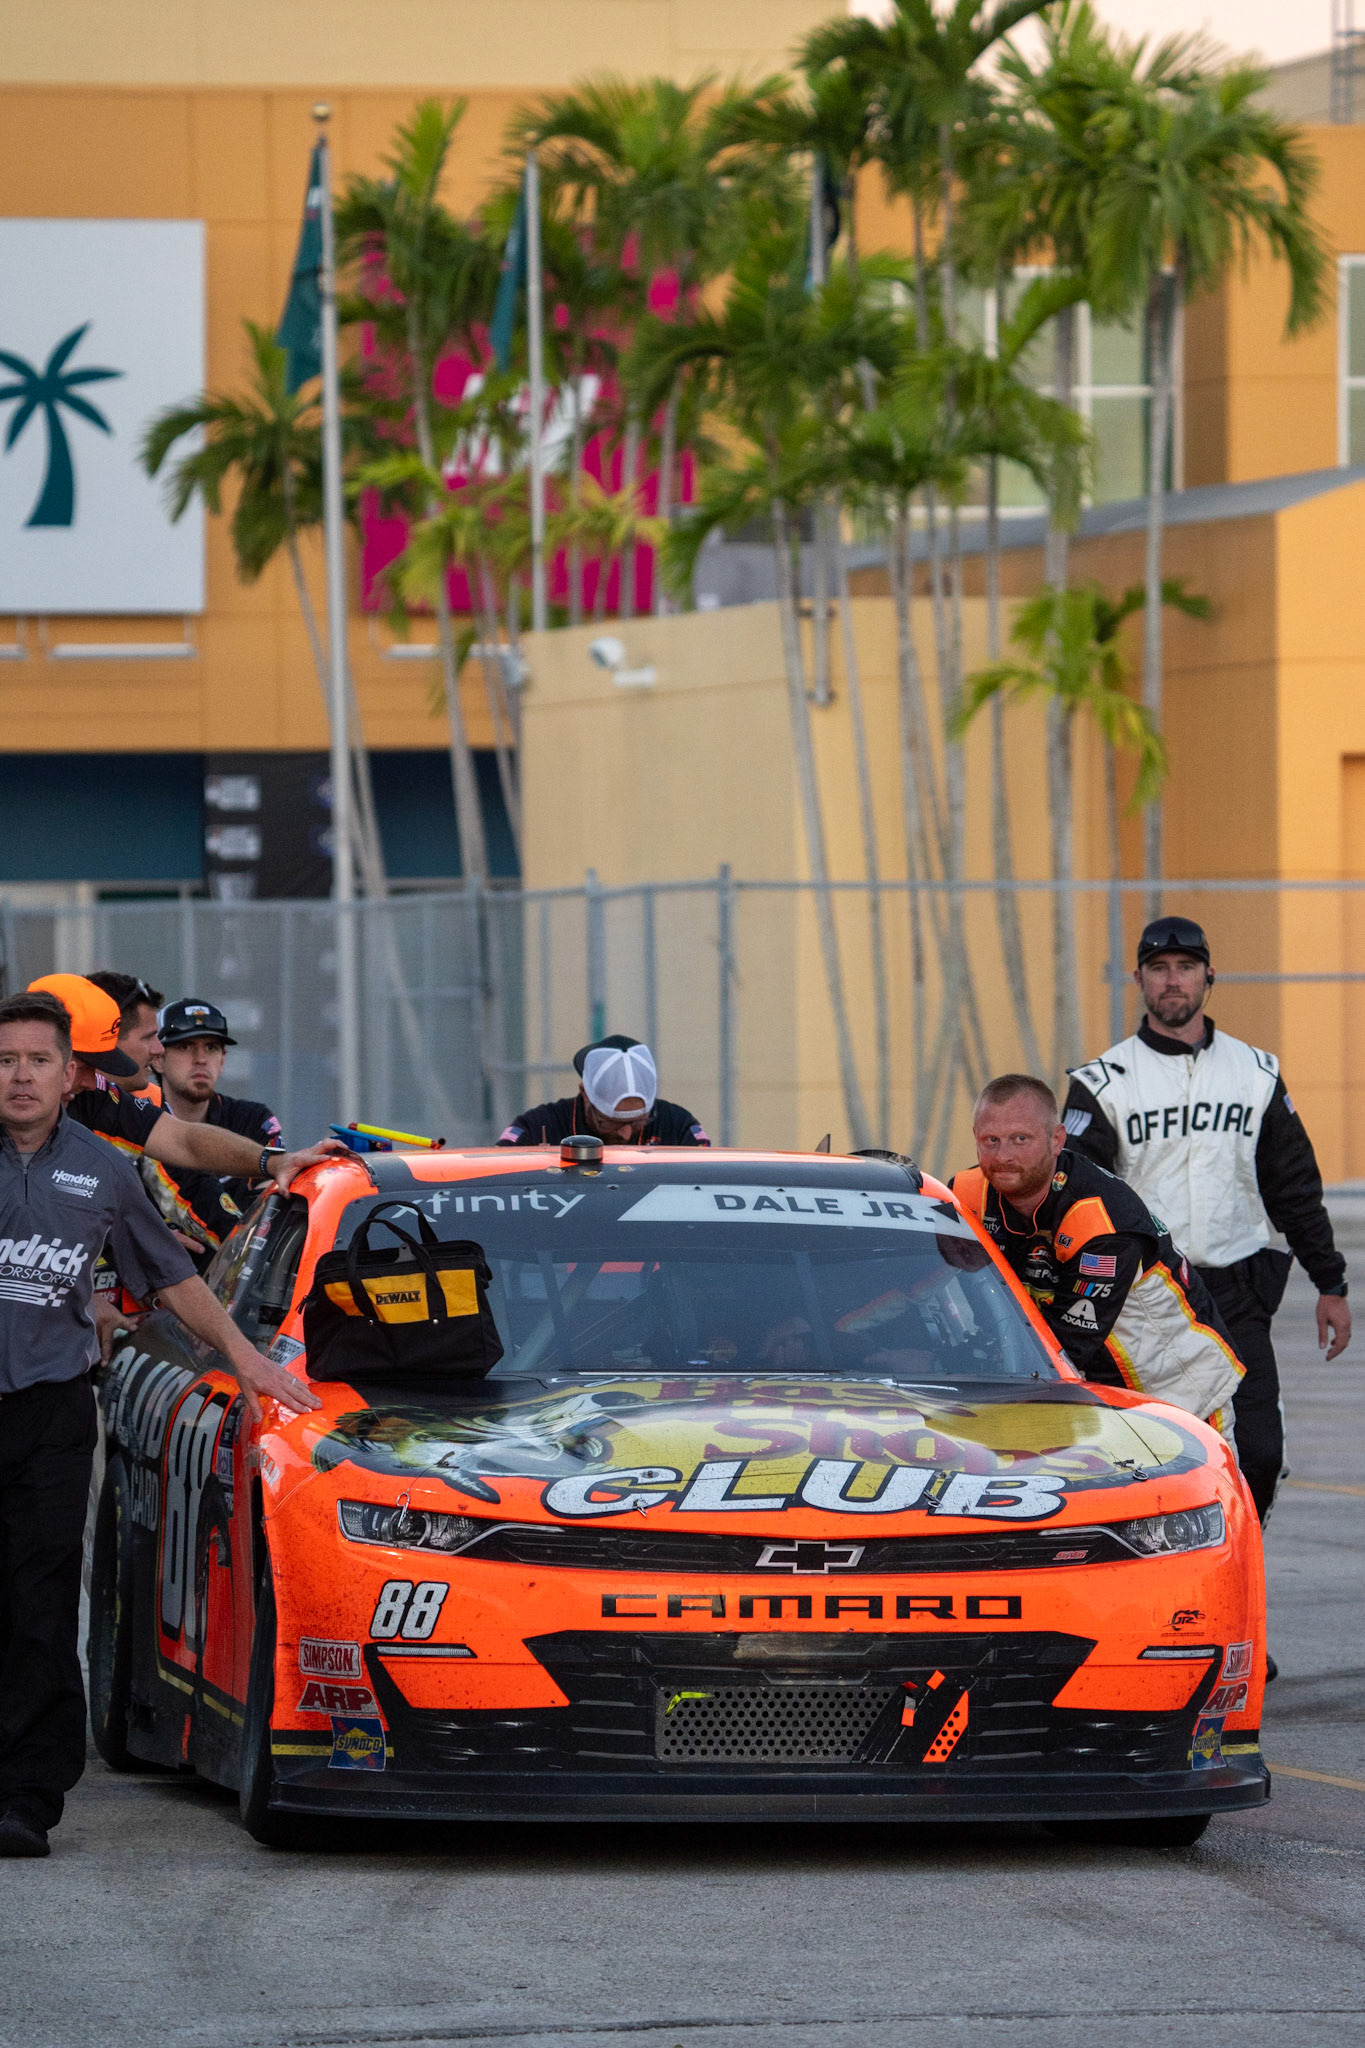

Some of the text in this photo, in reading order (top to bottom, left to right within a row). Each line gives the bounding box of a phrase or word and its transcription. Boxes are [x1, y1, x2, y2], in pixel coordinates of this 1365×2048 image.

[1127, 1102, 1253, 1145] OFFICIAL
[52, 1169, 99, 1188] Hendrick
[391, 1189, 586, 1222] xfinity
[713, 1194, 935, 1222] DALE JR.
[0, 1264, 77, 1288] ORSPORTS
[1091, 1283, 1114, 1298] 75
[1060, 1313, 1099, 1330] AXALTA
[703, 1418, 1118, 1476] Shops
[544, 1459, 1070, 1519] CLUB
[370, 1580, 450, 1640] 88
[601, 1594, 1022, 1620] CAMARO
[302, 1644, 354, 1672] SIMPSON
[300, 1682, 373, 1711] ARP
[1203, 1683, 1247, 1711] ARP
[336, 1736, 381, 1751] SUNOCO
